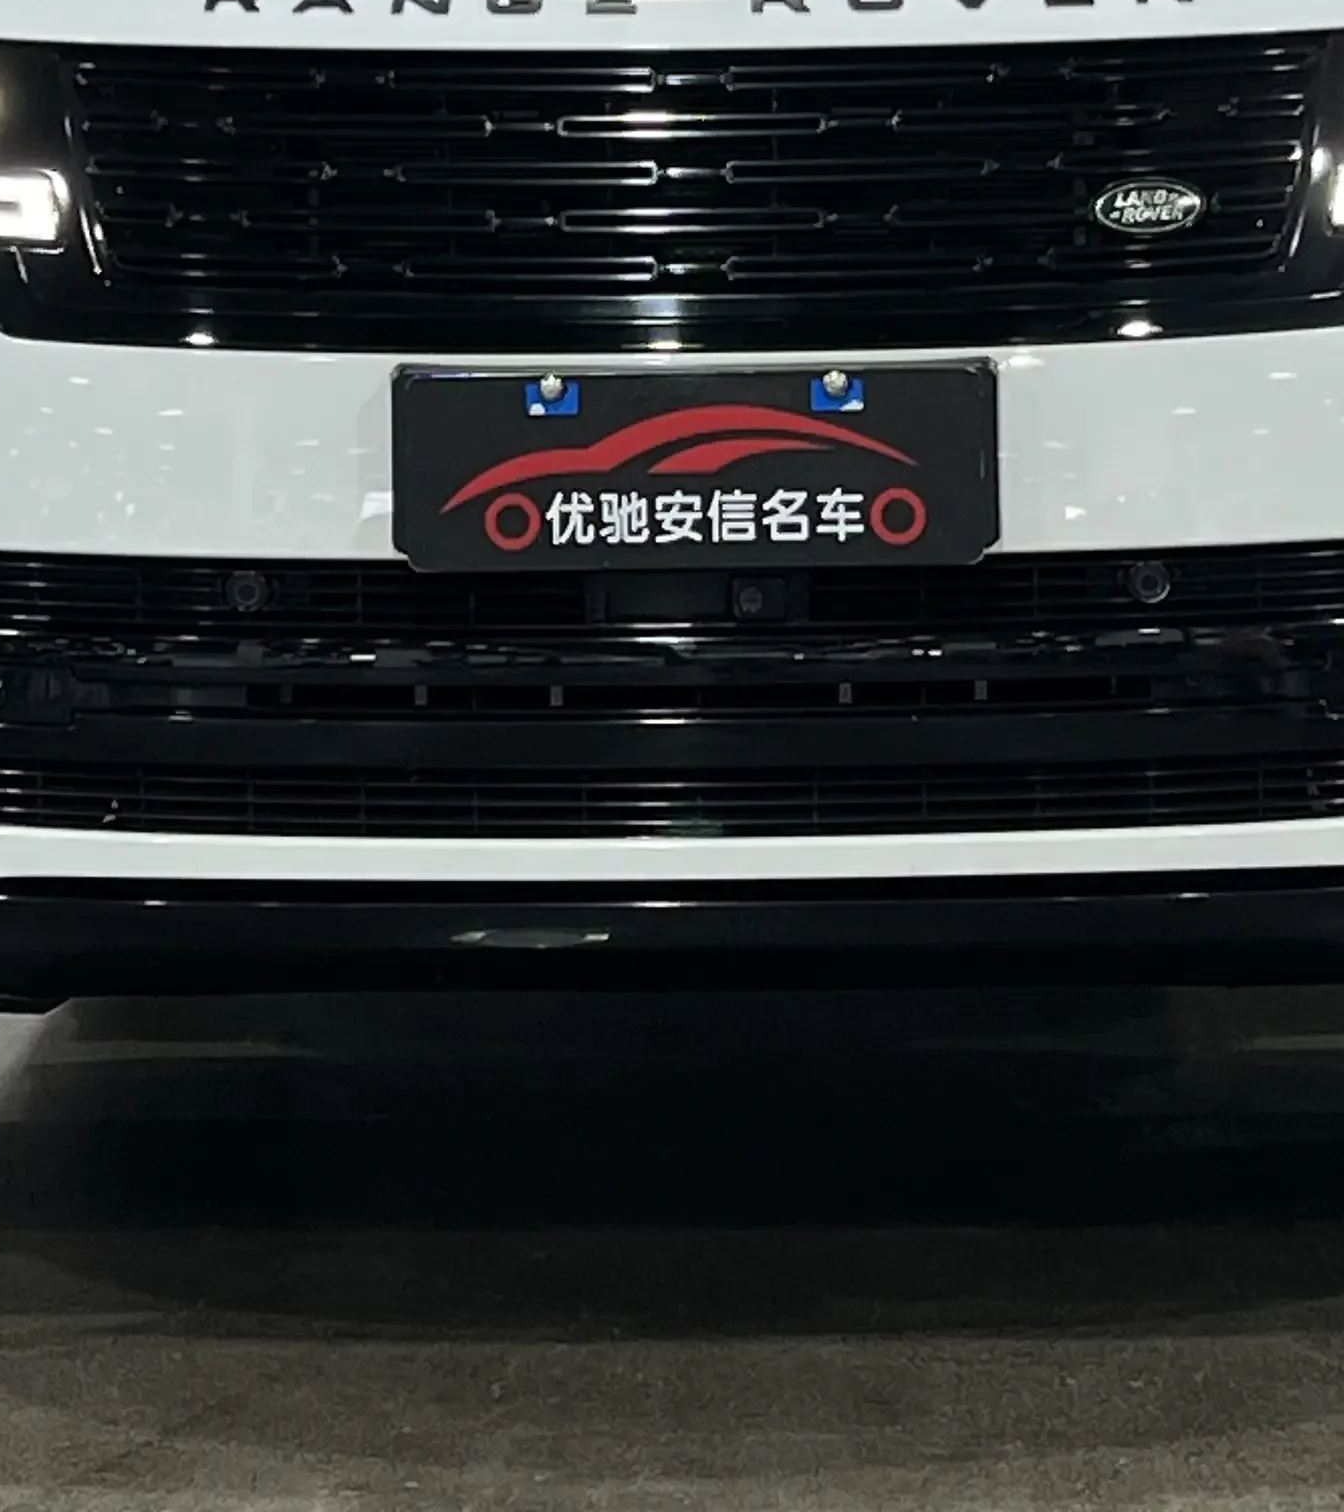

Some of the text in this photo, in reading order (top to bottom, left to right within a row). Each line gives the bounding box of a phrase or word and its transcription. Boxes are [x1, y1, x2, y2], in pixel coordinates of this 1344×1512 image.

[1114, 189, 1168, 208] LAND
[1121, 205, 1183, 224] ROVER
[545, 487, 866, 545] 优驰安信名车
